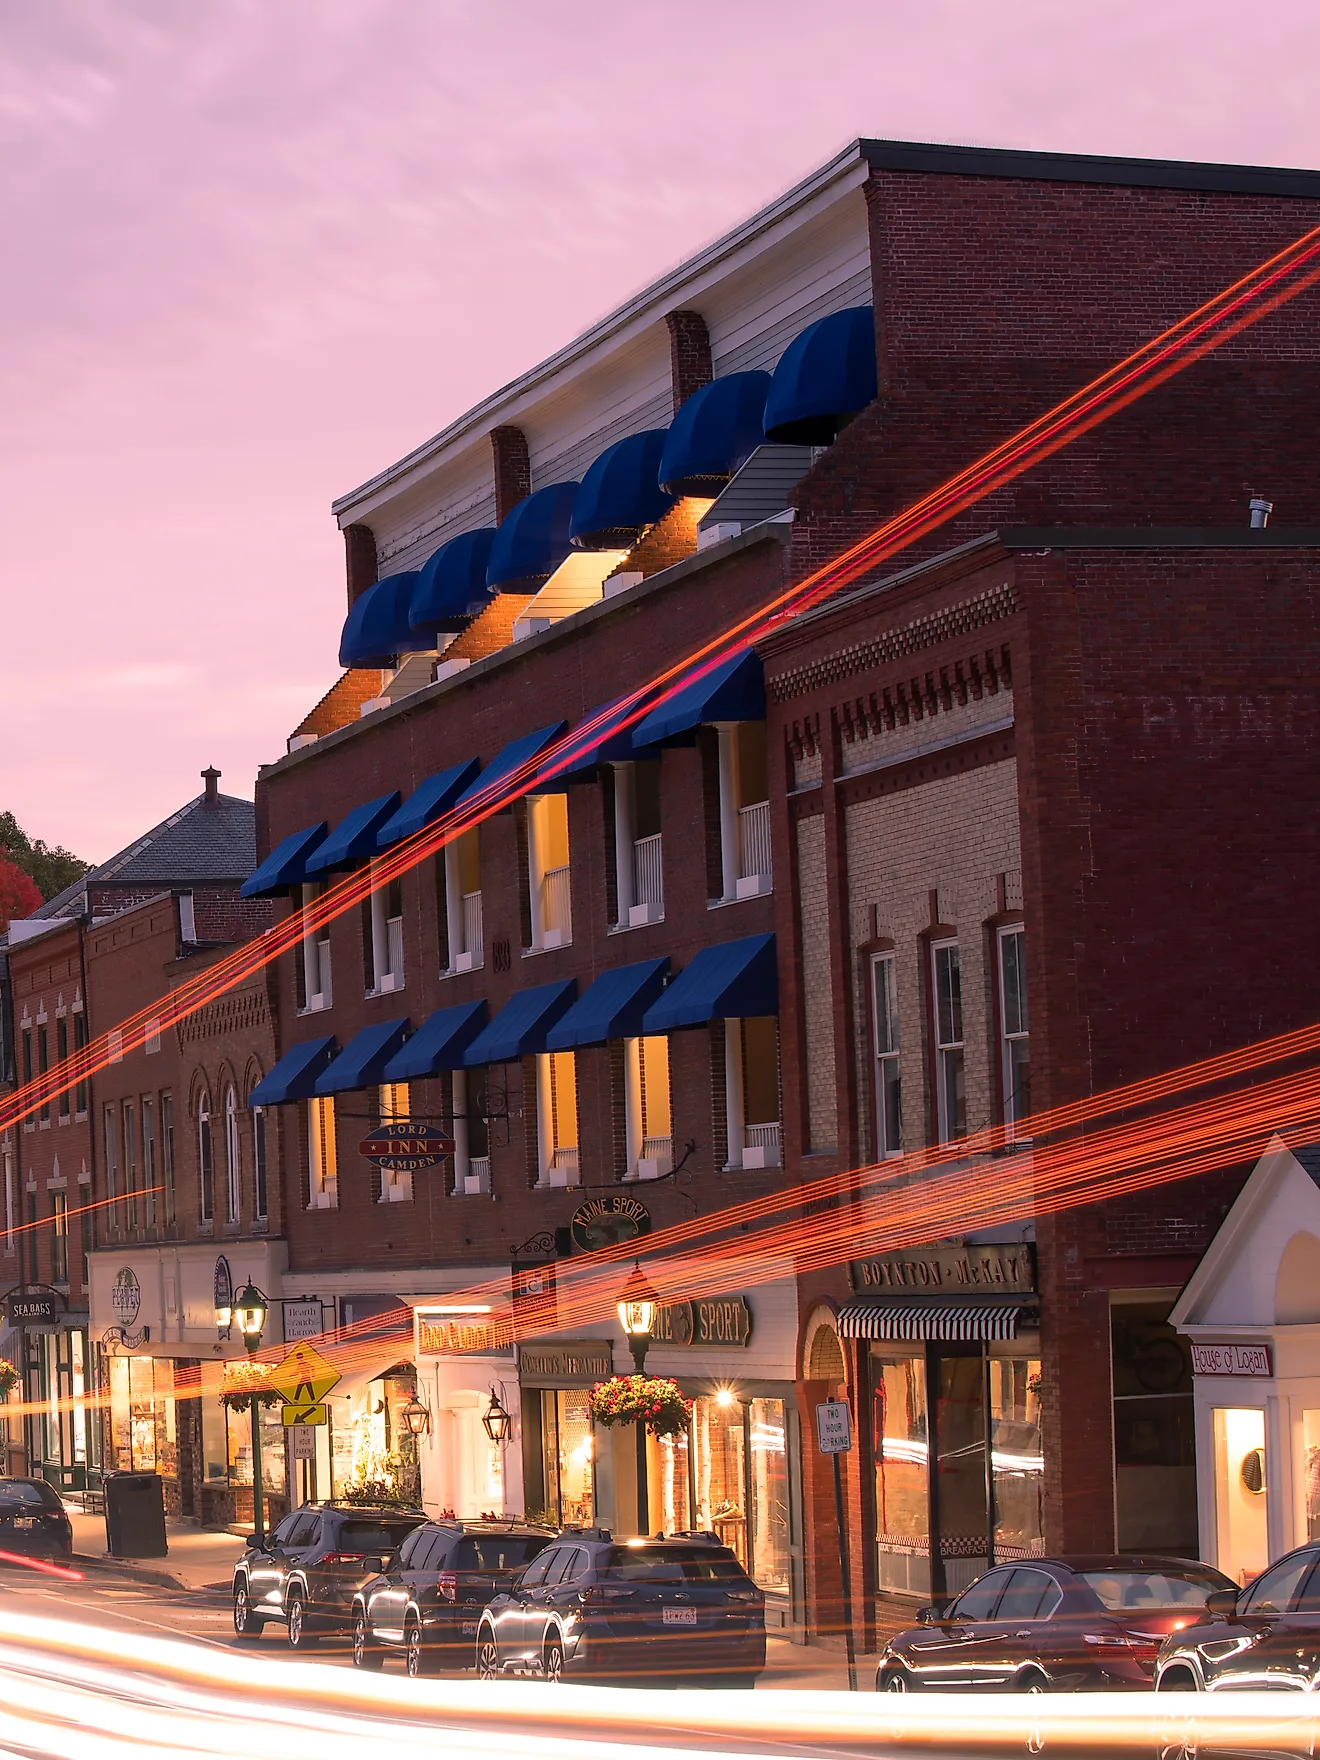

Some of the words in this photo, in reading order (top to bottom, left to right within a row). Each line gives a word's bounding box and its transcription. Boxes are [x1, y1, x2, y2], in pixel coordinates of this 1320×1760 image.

[388, 1125, 427, 1136] LORD
[387, 1140, 428, 1154] INN
[379, 1155, 435, 1170] CAMDEN
[573, 1199, 608, 1227] MAINE
[612, 1197, 649, 1221] SPORT
[861, 1261, 941, 1286] BOYNTON
[954, 1257, 1019, 1285] McKAY
[13, 1303, 28, 1317] SEA
[30, 1302, 51, 1315] BAGS
[289, 1308, 316, 1317] Hearth
[700, 1303, 740, 1340] SPORT
[1192, 1346, 1221, 1373] House
[1224, 1346, 1233, 1373] of
[1234, 1347, 1268, 1374] Logan
[827, 1409, 839, 1418] TWO
[826, 1422, 842, 1433] HOUR
[940, 1545, 989, 1556] BREAKFAST
